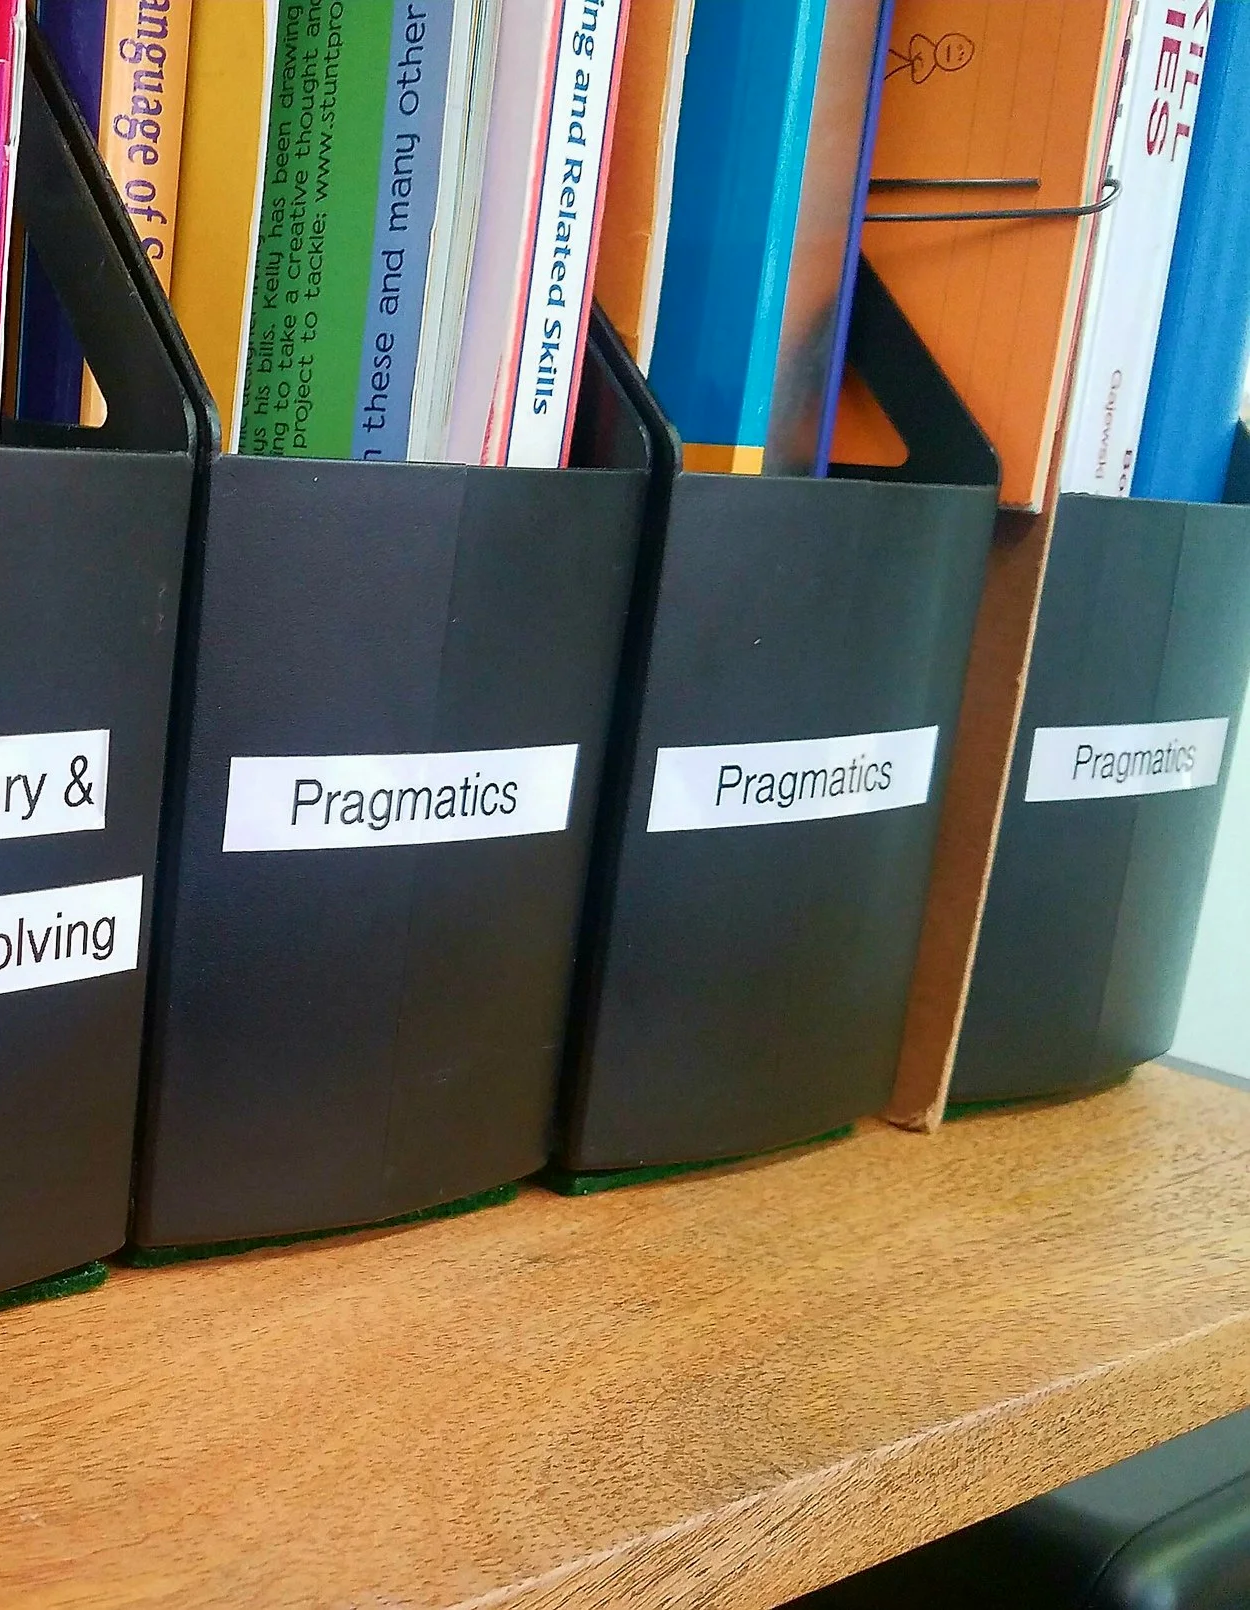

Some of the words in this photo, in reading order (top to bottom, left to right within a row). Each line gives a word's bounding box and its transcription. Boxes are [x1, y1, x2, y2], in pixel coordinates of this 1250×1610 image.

[278, 5, 303, 109] drawing
[396, 3, 427, 116] other
[295, 48, 319, 159] thought
[315, 1, 344, 202] www.stuntpro
[567, 69, 591, 146] and
[271, 121, 292, 184] been
[388, 133, 420, 231] many
[123, 179, 168, 225] of
[268, 197, 286, 238] has
[288, 170, 308, 280] creative
[547, 158, 583, 307] Related
[262, 251, 285, 309] Kelly
[286, 290, 299, 304] a
[379, 248, 405, 315] and
[257, 323, 276, 374] bills.
[278, 314, 297, 372] take
[300, 311, 318, 343] to
[362, 332, 394, 433] these
[533, 318, 562, 415] Skills
[254, 385, 271, 415] his
[274, 381, 290, 412] to
[293, 354, 314, 449] project
[254, 427, 269, 455] ys
[64, 755, 95, 807] &
[715, 754, 893, 808] Pragmatics
[1072, 738, 1197, 784] Pragmatics
[290, 772, 518, 831] Pragmatics
